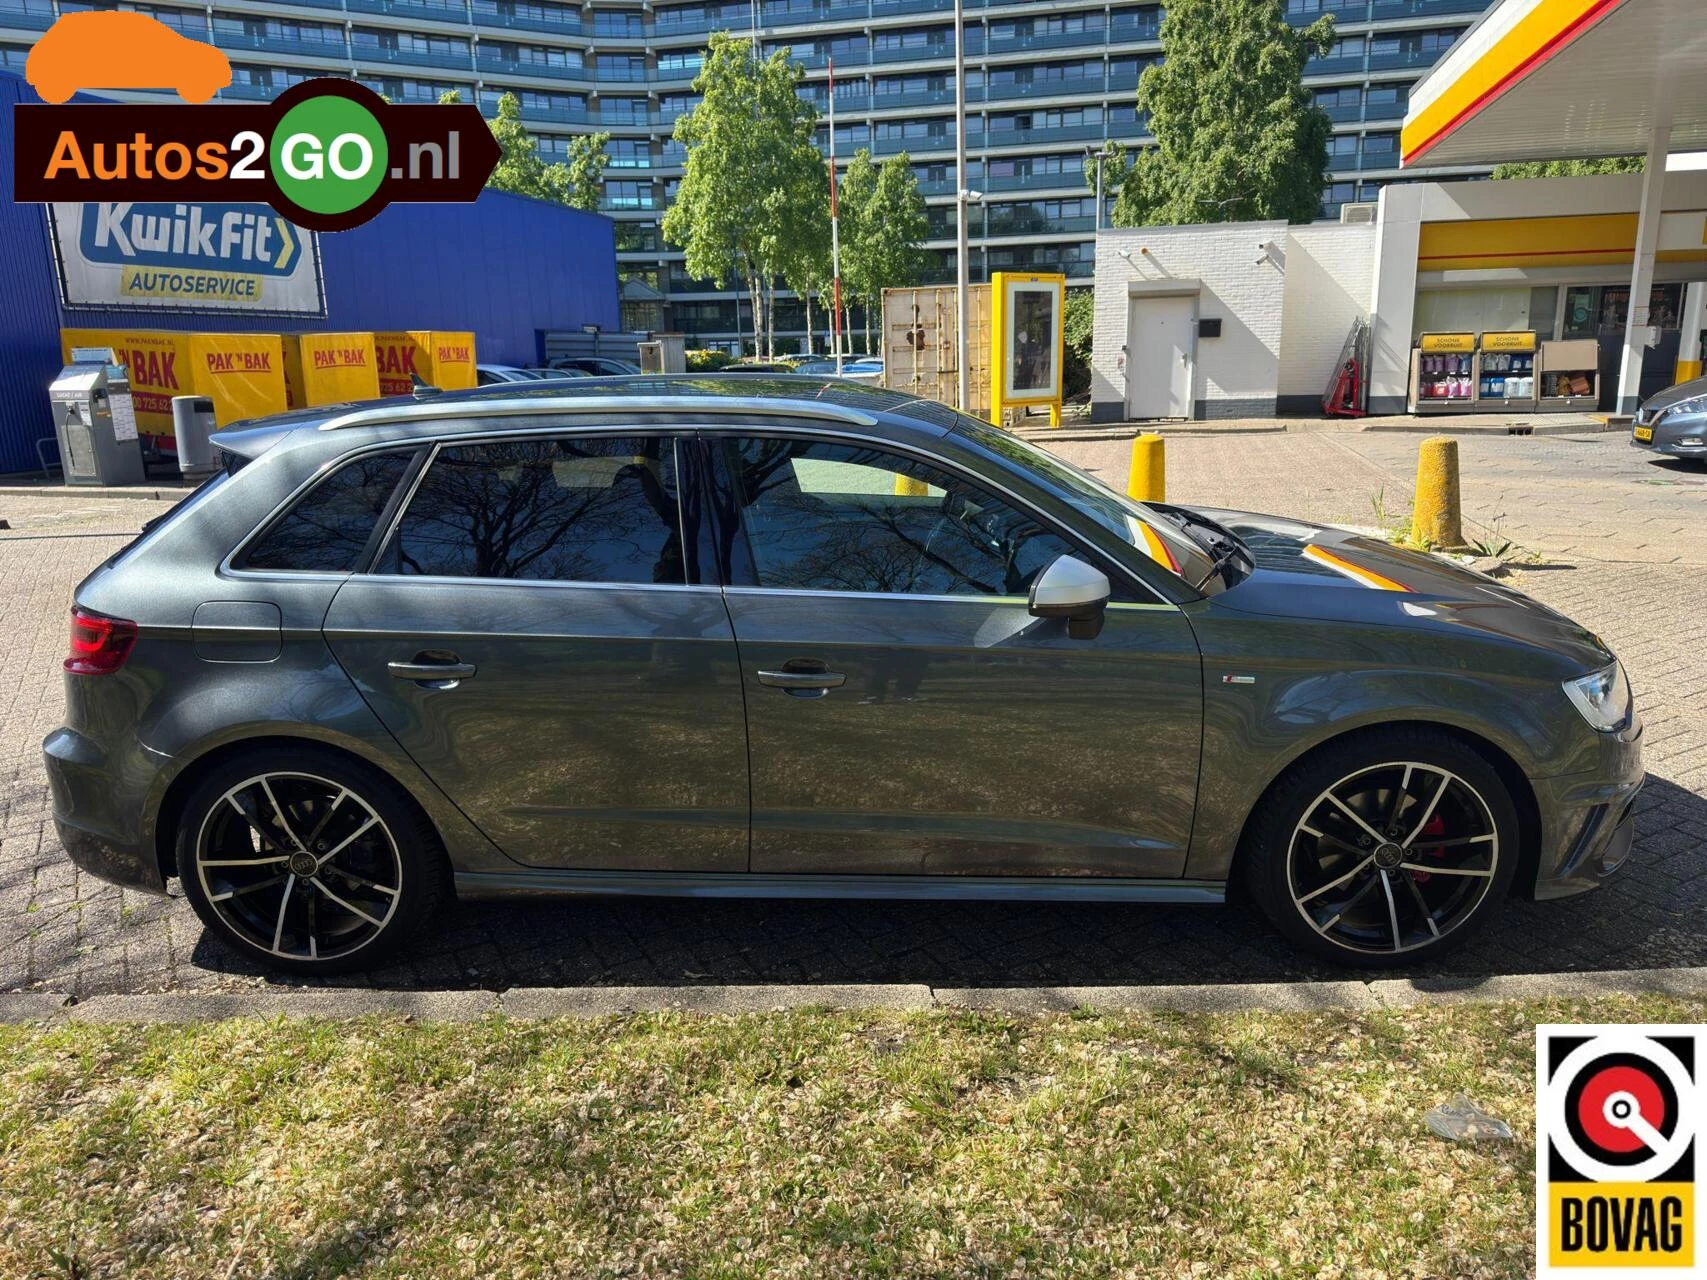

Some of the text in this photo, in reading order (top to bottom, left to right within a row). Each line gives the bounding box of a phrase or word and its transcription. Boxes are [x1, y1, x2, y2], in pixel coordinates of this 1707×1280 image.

[129, 273, 255, 296] AUTOSERVICE
[207, 353, 234, 370] PAK
[244, 352, 271, 370] BAK
[313, 350, 336, 366] PAK
[343, 349, 366, 364] BAK
[375, 346, 418, 375] BAK
[438, 347, 451, 360] PAK
[456, 347, 470, 360] BAK
[132, 350, 179, 390] BAK
